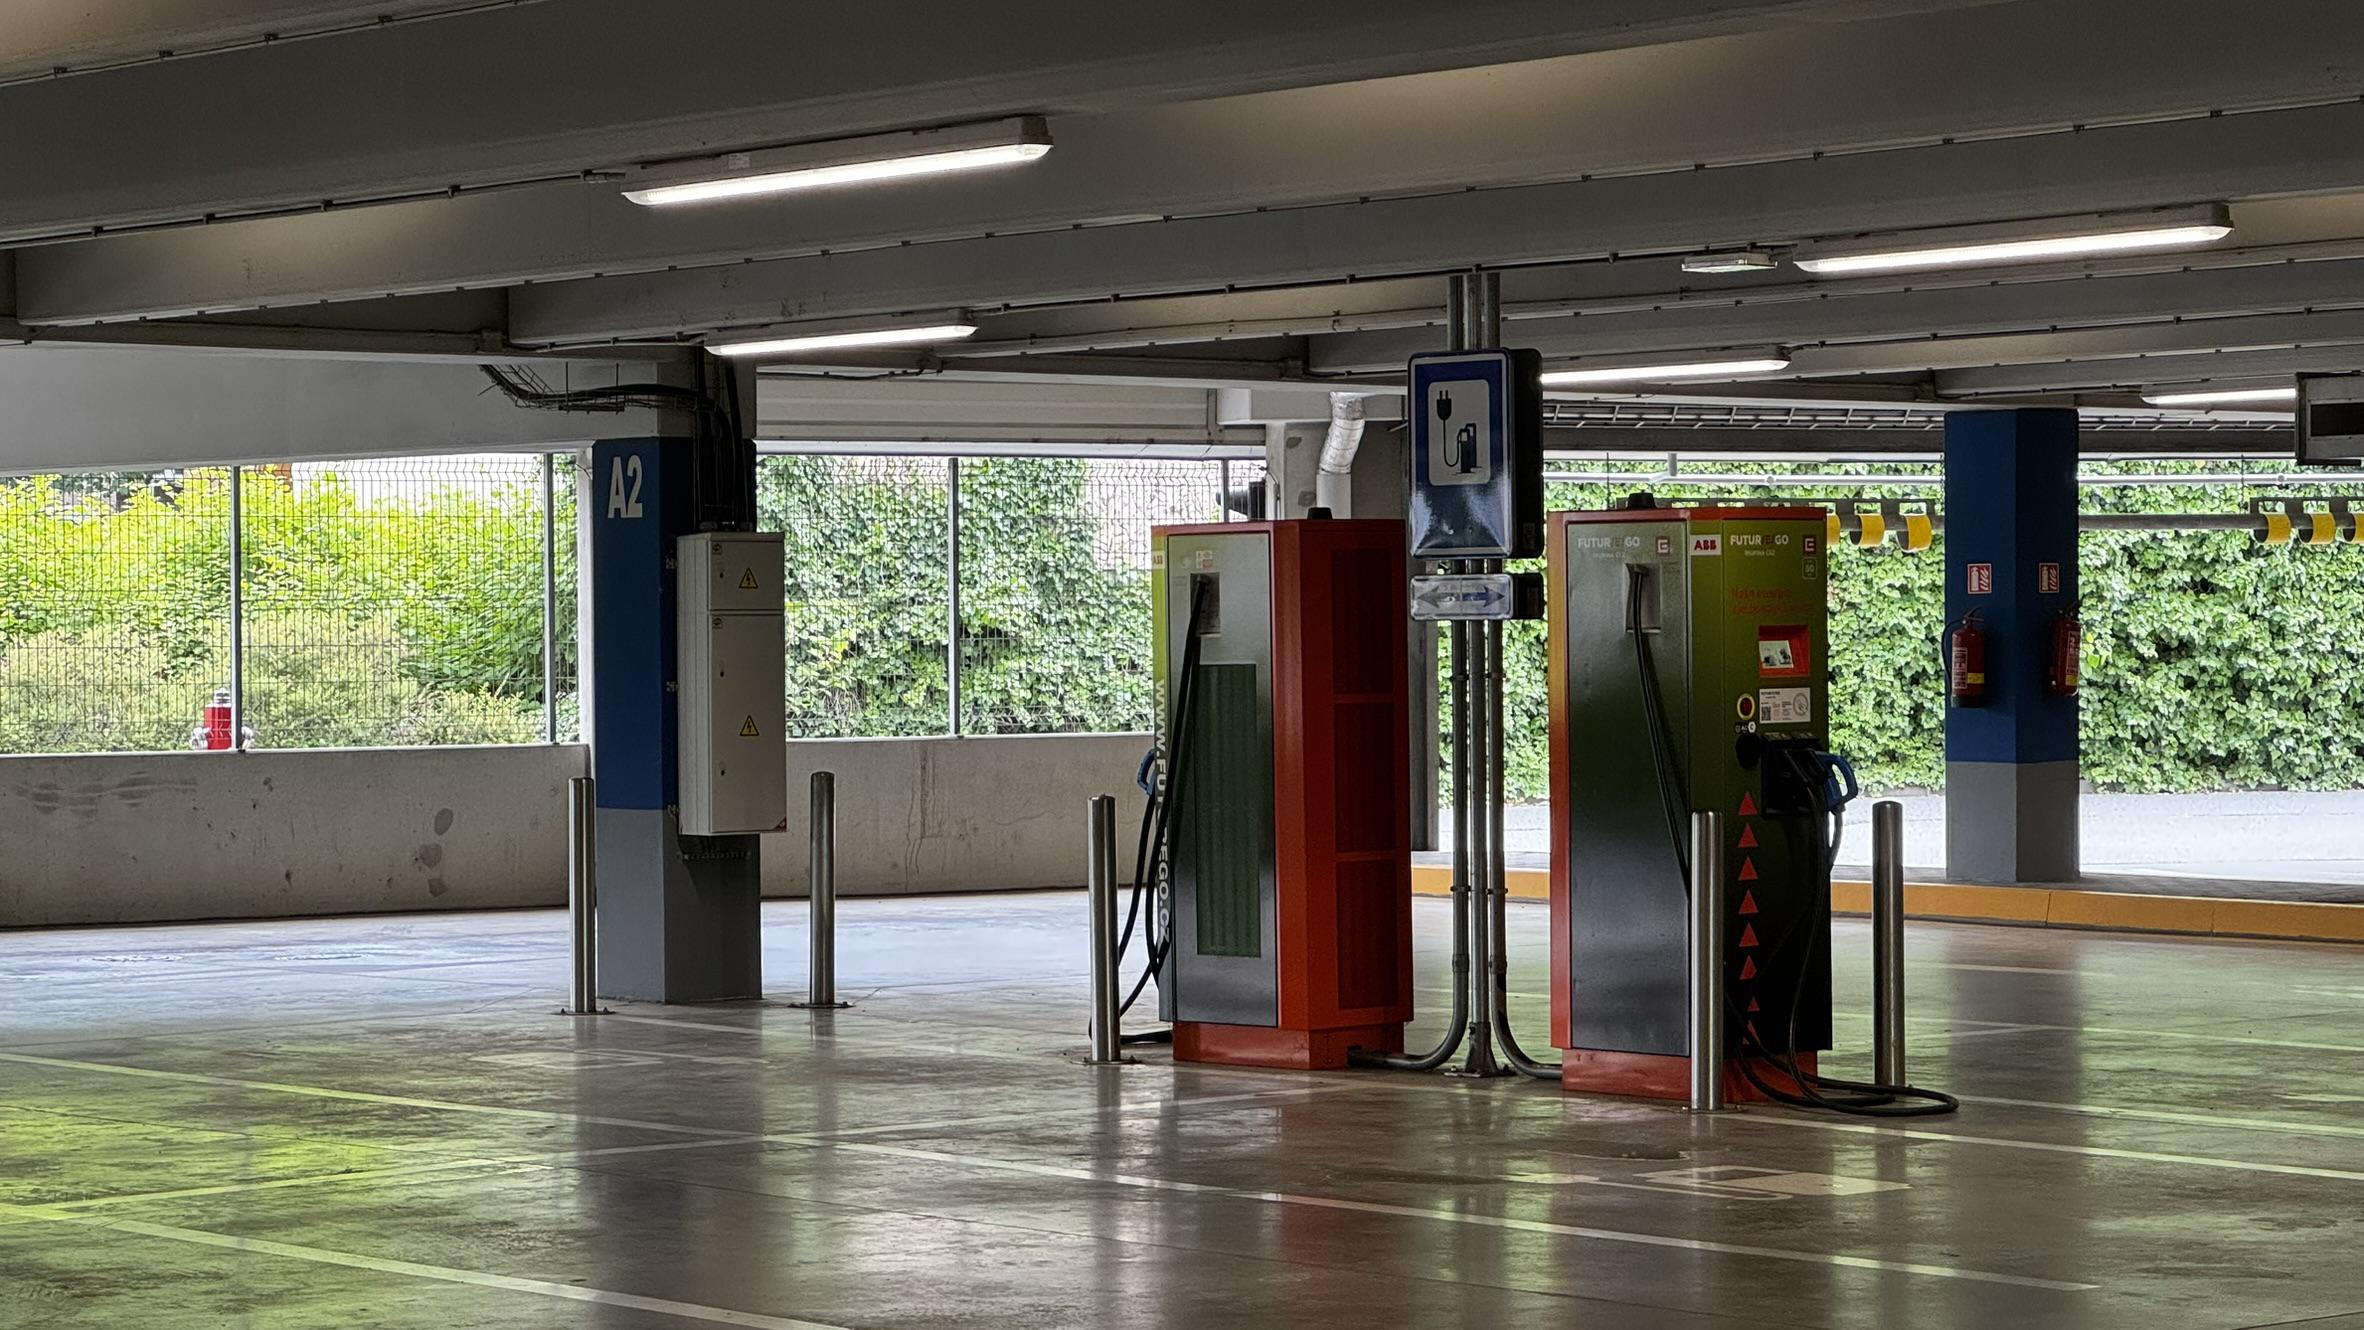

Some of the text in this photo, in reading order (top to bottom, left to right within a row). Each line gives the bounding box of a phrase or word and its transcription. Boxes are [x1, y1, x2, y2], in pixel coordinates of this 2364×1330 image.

[608, 454, 643, 519] A2
[1694, 539, 1717, 551] ABB
[1154, 680, 1170, 943] WWW.FUEGO.CZ
